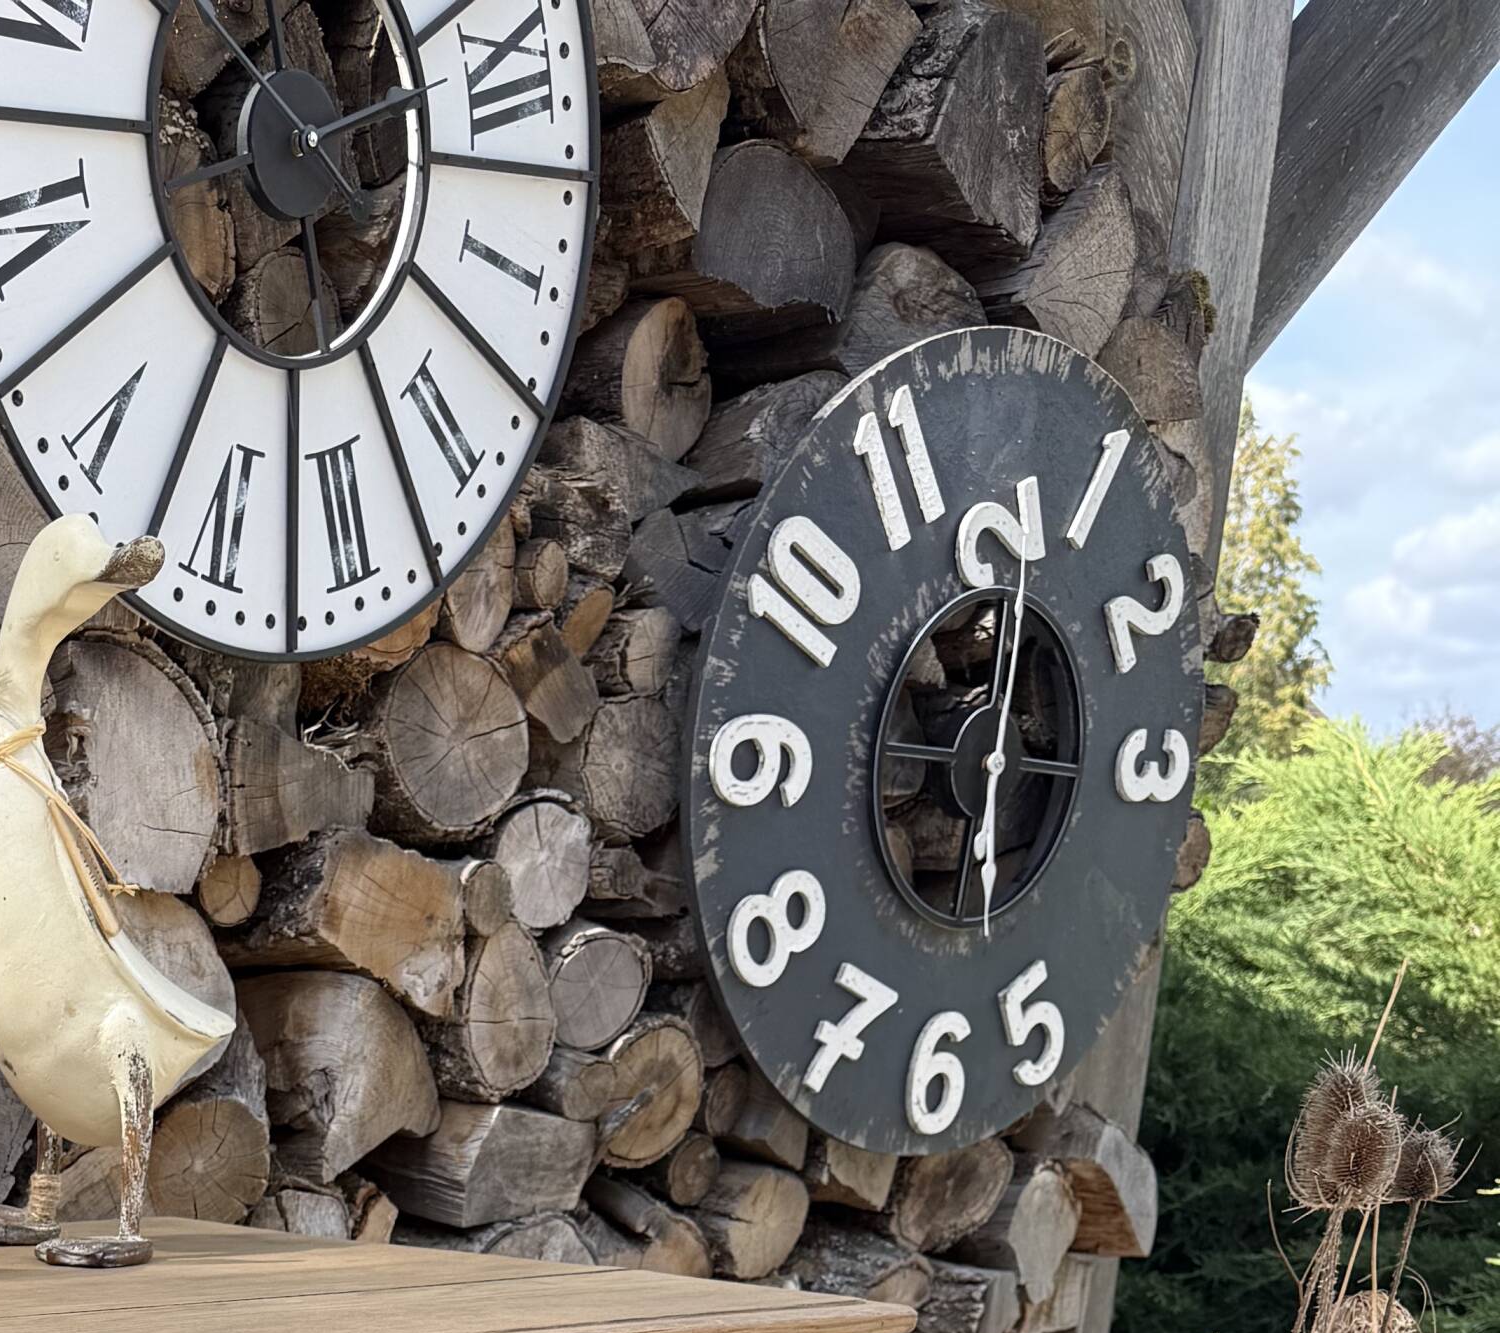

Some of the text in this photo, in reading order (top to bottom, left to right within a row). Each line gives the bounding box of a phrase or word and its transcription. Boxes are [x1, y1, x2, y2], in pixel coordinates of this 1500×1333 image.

[458, 219, 545, 305] I
[61, 362, 148, 495] V
[400, 349, 485, 497] II
[852, 384, 945, 551] 11
[178, 443, 266, 593] IV
[304, 434, 380, 593] III
[1065, 429, 1131, 550] 1
[747, 515, 861, 668] 10
[1105, 553, 1185, 675] 2
[709, 712, 813, 808] 9
[1115, 727, 1190, 803] 3
[726, 869, 827, 988] 8
[803, 961, 898, 1092] 7
[906, 1010, 973, 1136] 6
[997, 958, 1066, 1087] 5
